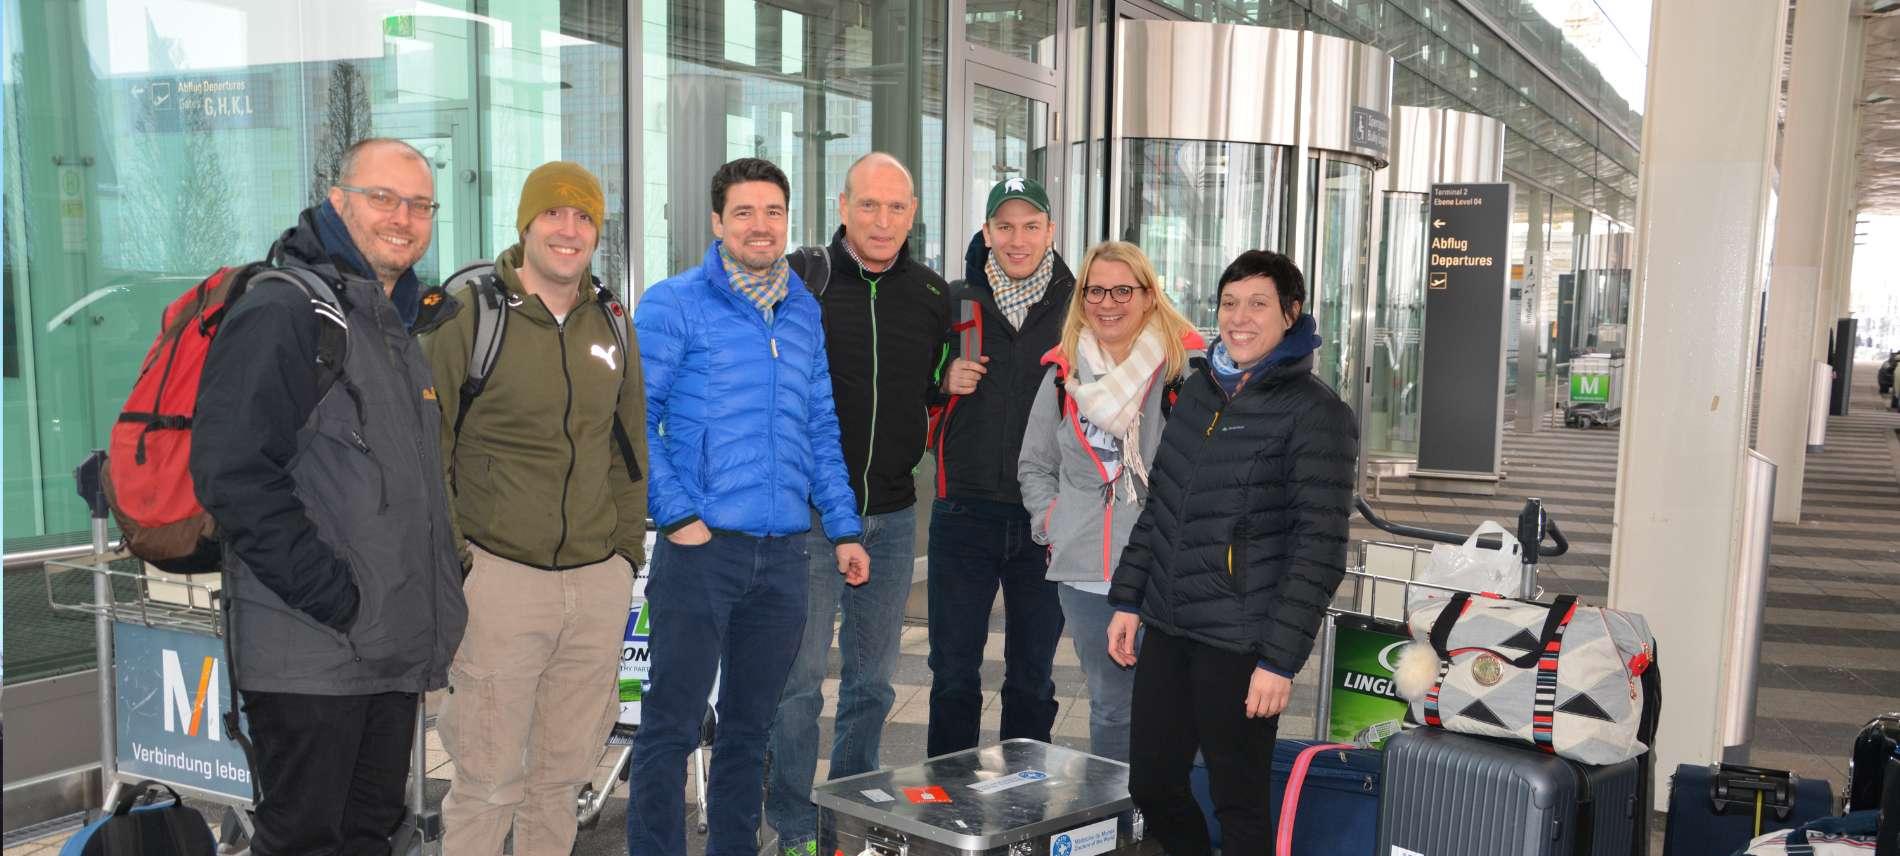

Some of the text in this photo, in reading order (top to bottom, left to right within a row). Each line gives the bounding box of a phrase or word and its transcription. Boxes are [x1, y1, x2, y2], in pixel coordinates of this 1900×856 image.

[177, 80, 246, 95] Abflug Departures
[1434, 188, 1468, 196] Terminal 2
[1434, 198, 1482, 206] Ebene Level 04
[1431, 237, 1468, 252] Abflug
[1431, 254, 1493, 268] Departures
[1580, 376, 1599, 394] M
[1344, 672, 1394, 697] LINGL
[162, 649, 220, 741] M
[132, 742, 212, 780] Verbindung
